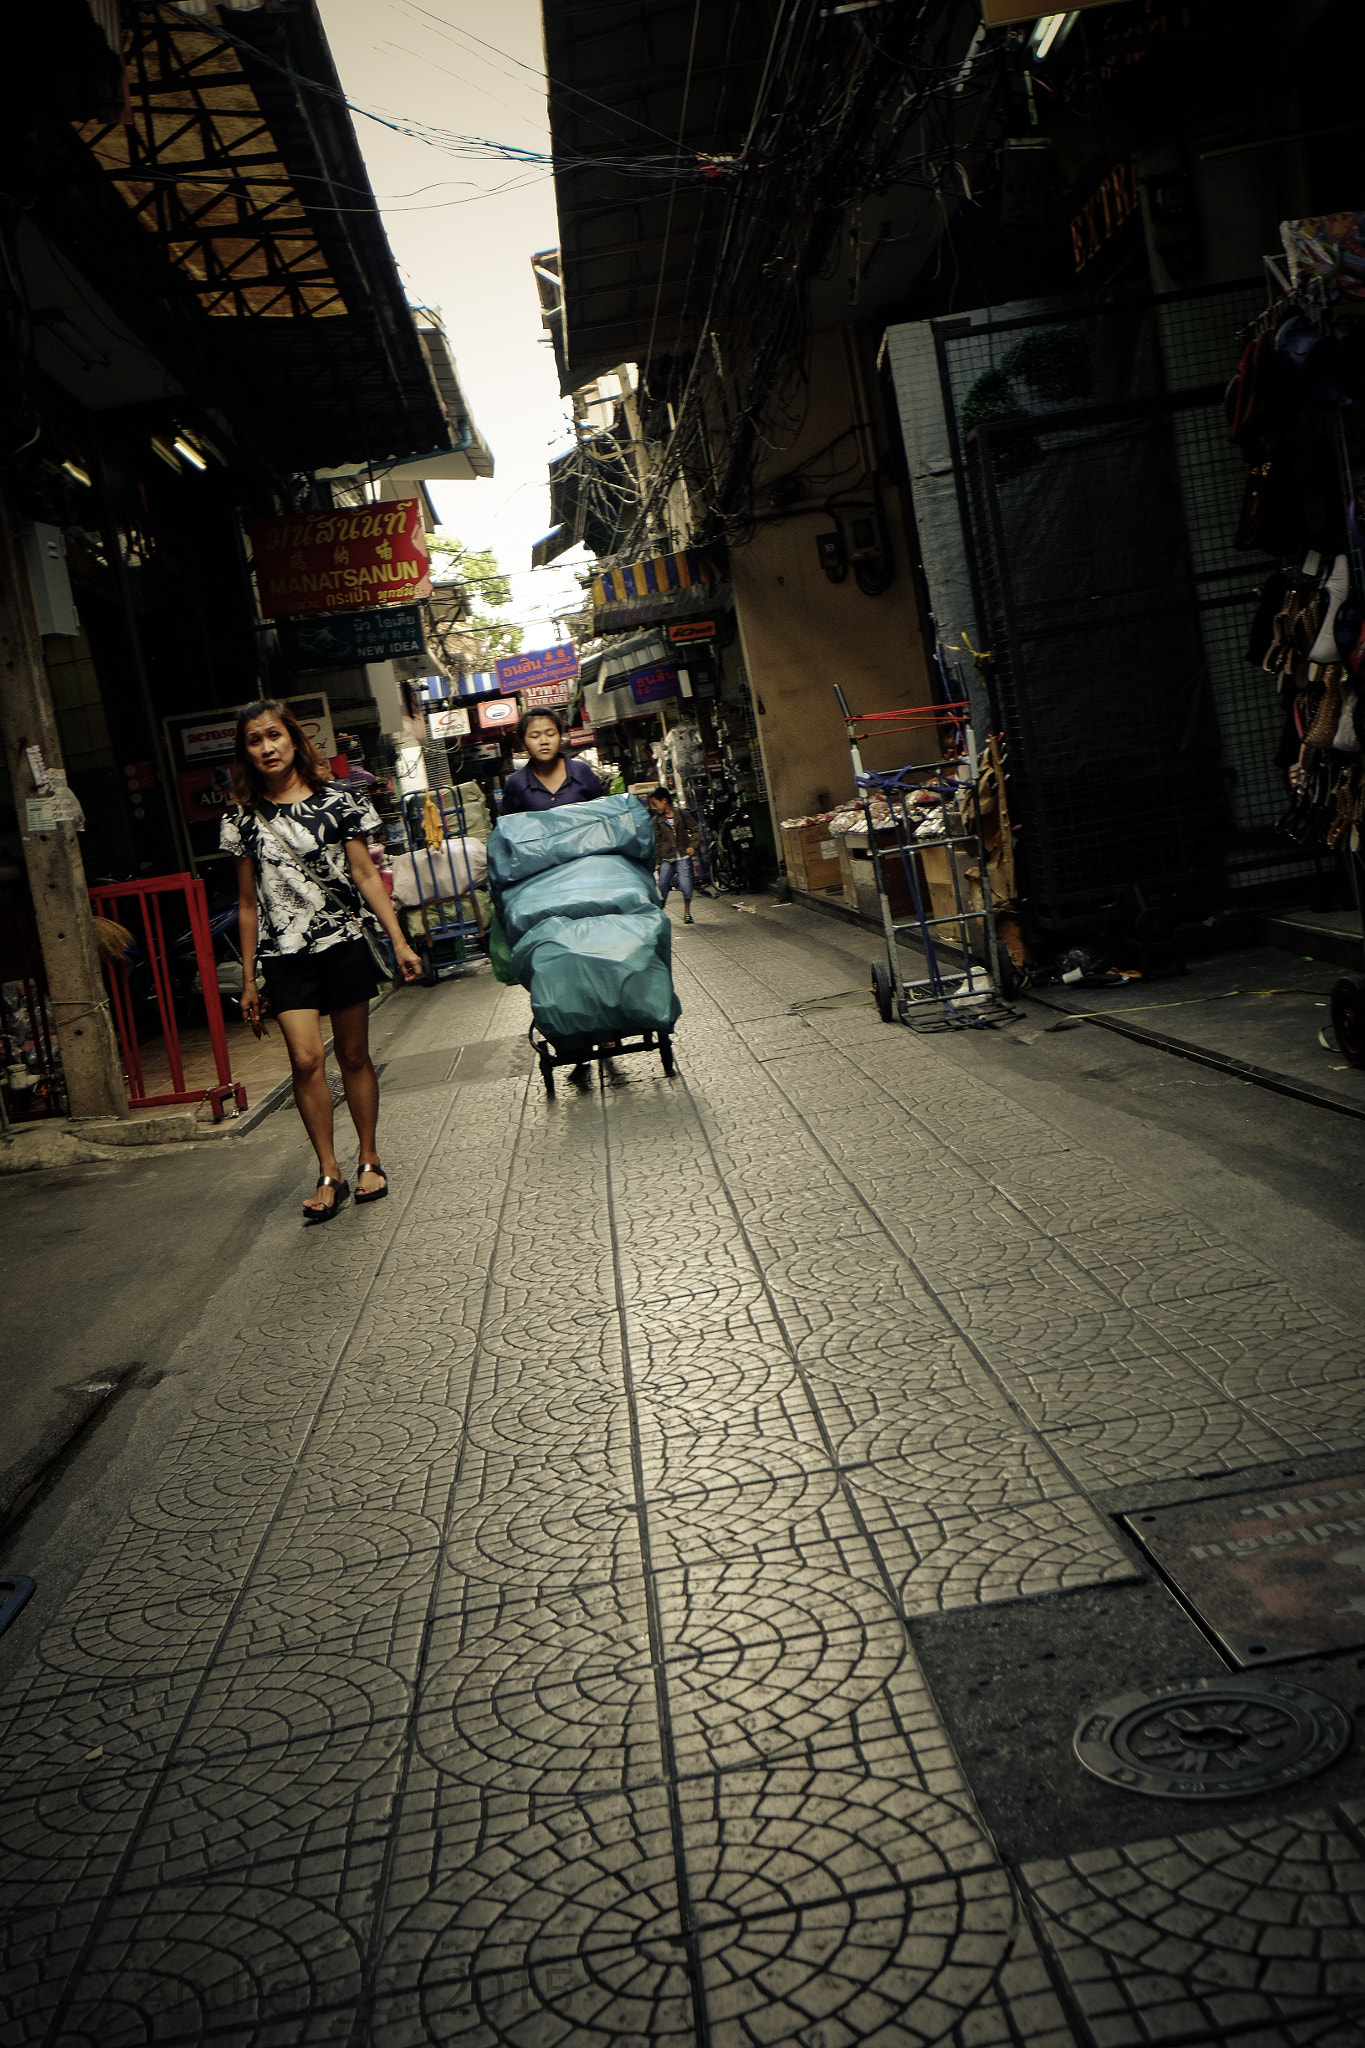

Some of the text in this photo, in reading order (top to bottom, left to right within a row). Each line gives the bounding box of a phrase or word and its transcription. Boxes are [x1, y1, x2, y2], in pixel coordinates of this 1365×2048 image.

[270, 560, 419, 596] MANATSANUN
[357, 640, 420, 658] NEW IDEA
[187, 727, 237, 744] aeroso
